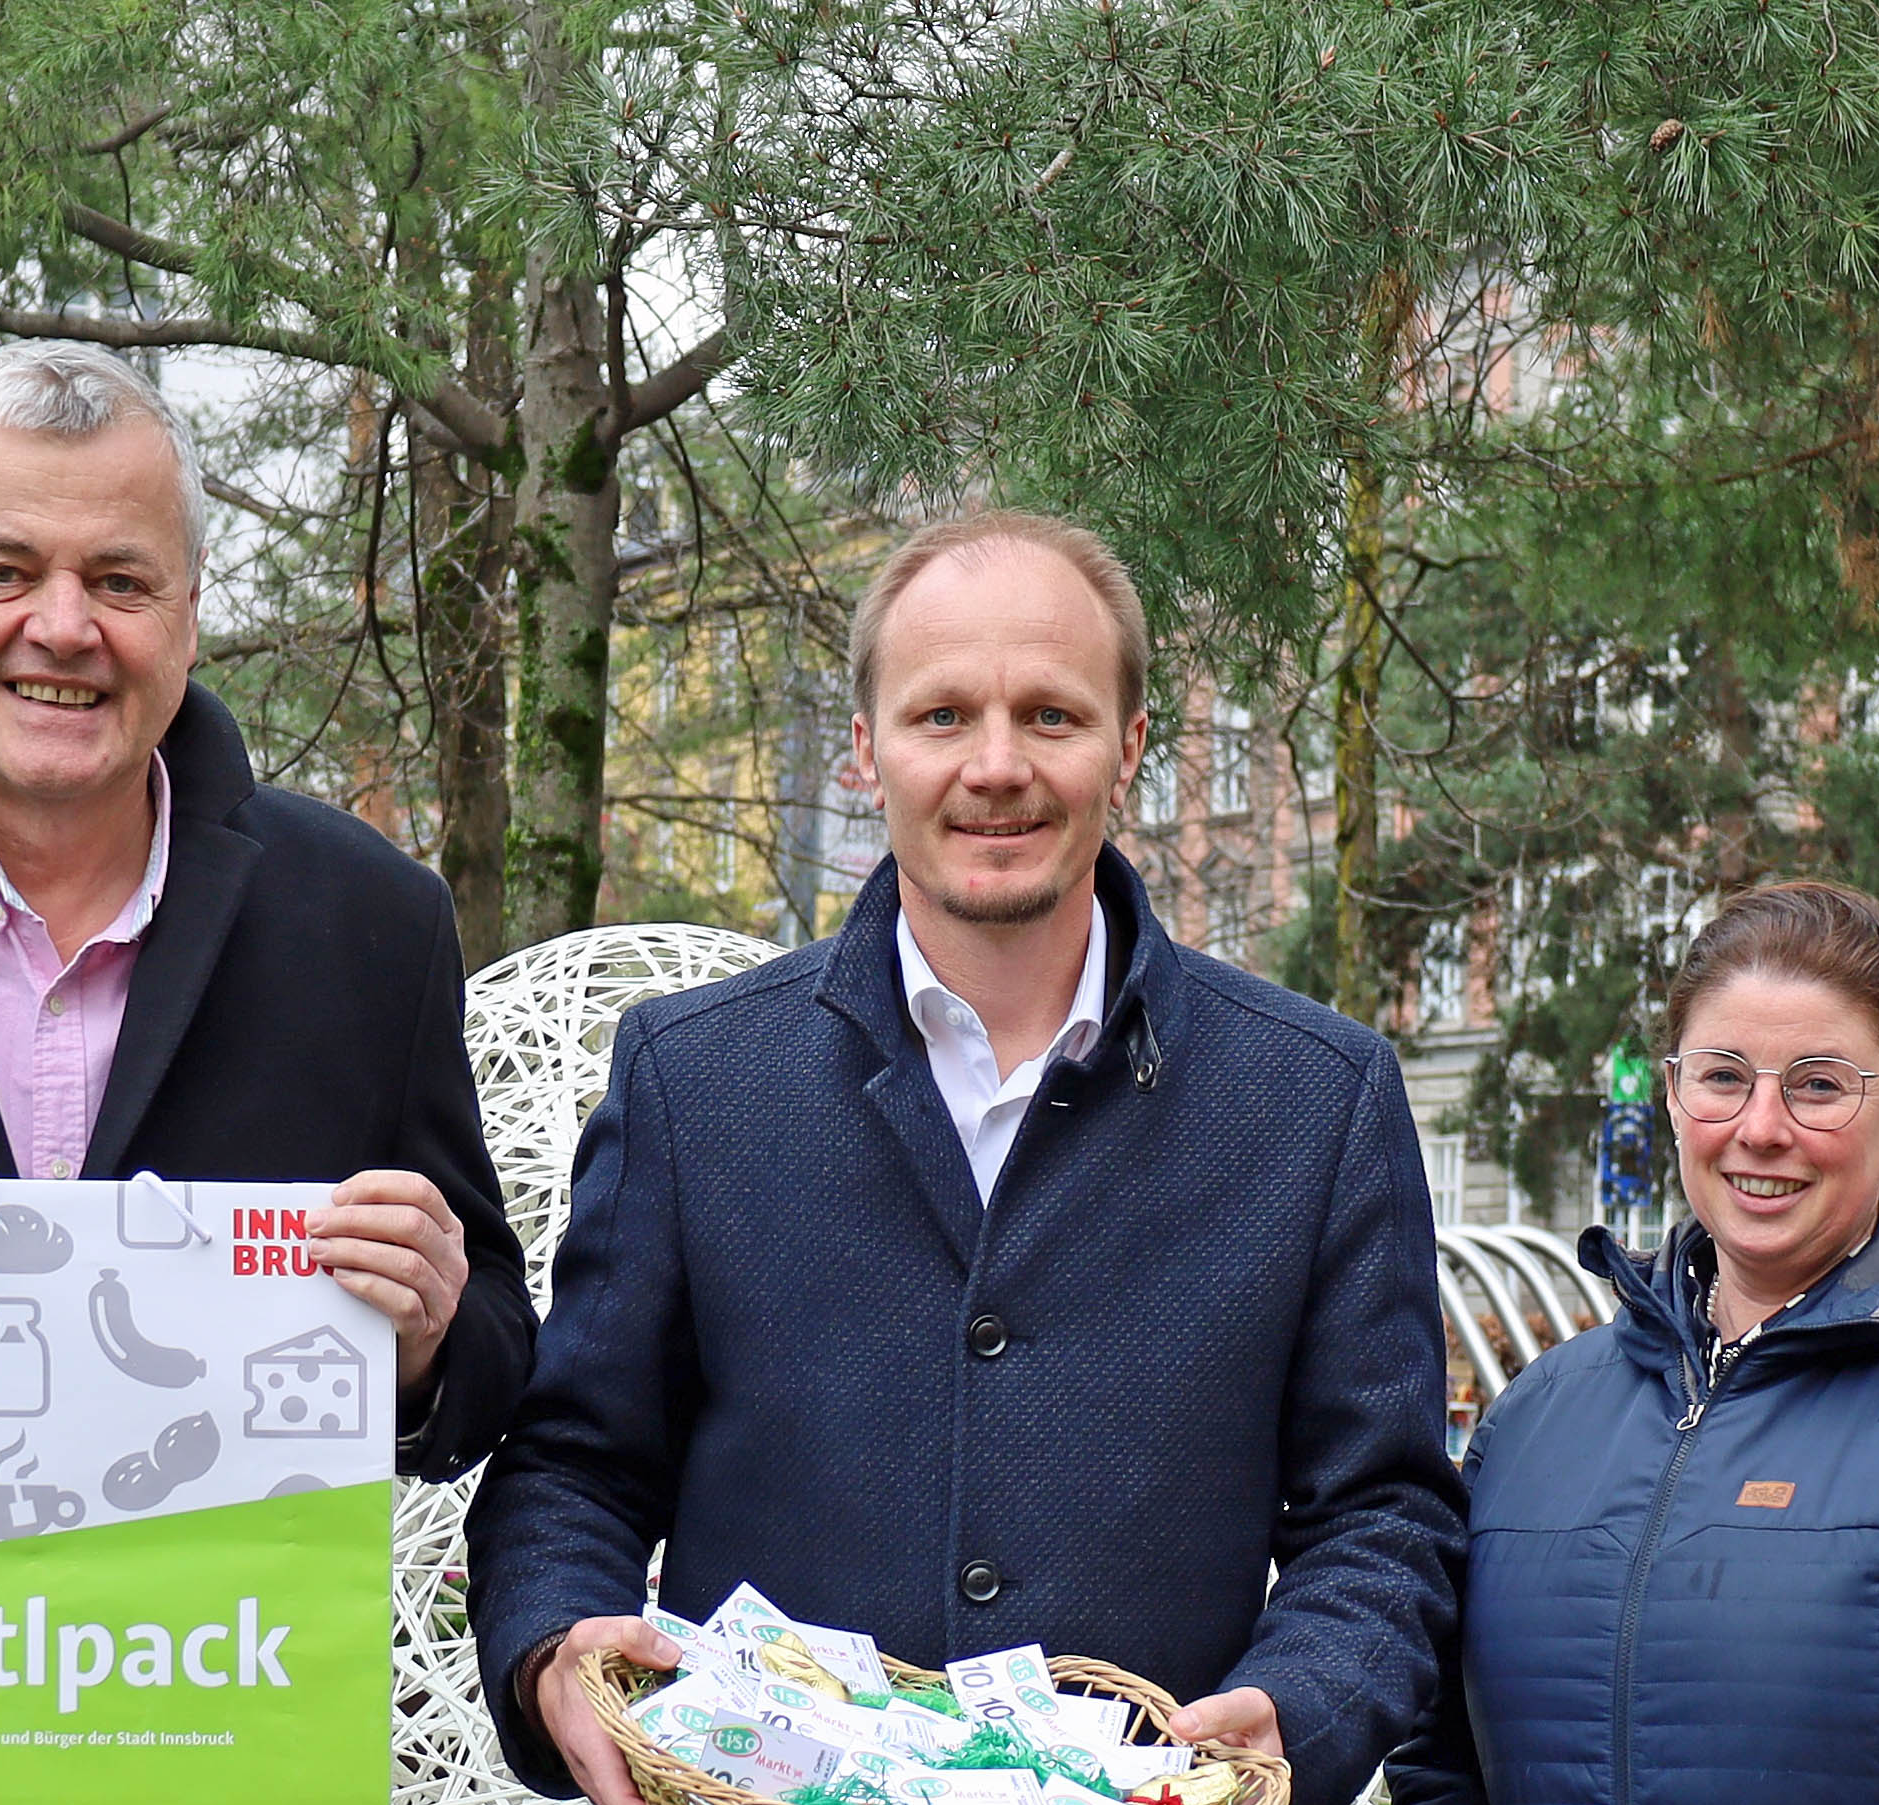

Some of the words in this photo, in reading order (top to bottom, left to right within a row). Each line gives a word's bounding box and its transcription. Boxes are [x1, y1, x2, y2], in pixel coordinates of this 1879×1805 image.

[233, 1208, 306, 1239] INN
[233, 1245, 334, 1276] BRU
[753, 1626, 782, 1642] tis
[957, 1662, 994, 1689] 10
[974, 1697, 1016, 1720] 10
[1, 1730, 30, 1745] und
[34, 1730, 84, 1749] Bürger
[88, 1730, 113, 1745] der
[117, 1731, 156, 1745] Stadt
[160, 1731, 234, 1745] Innsbruck
[755, 1753, 793, 1777] Markt
